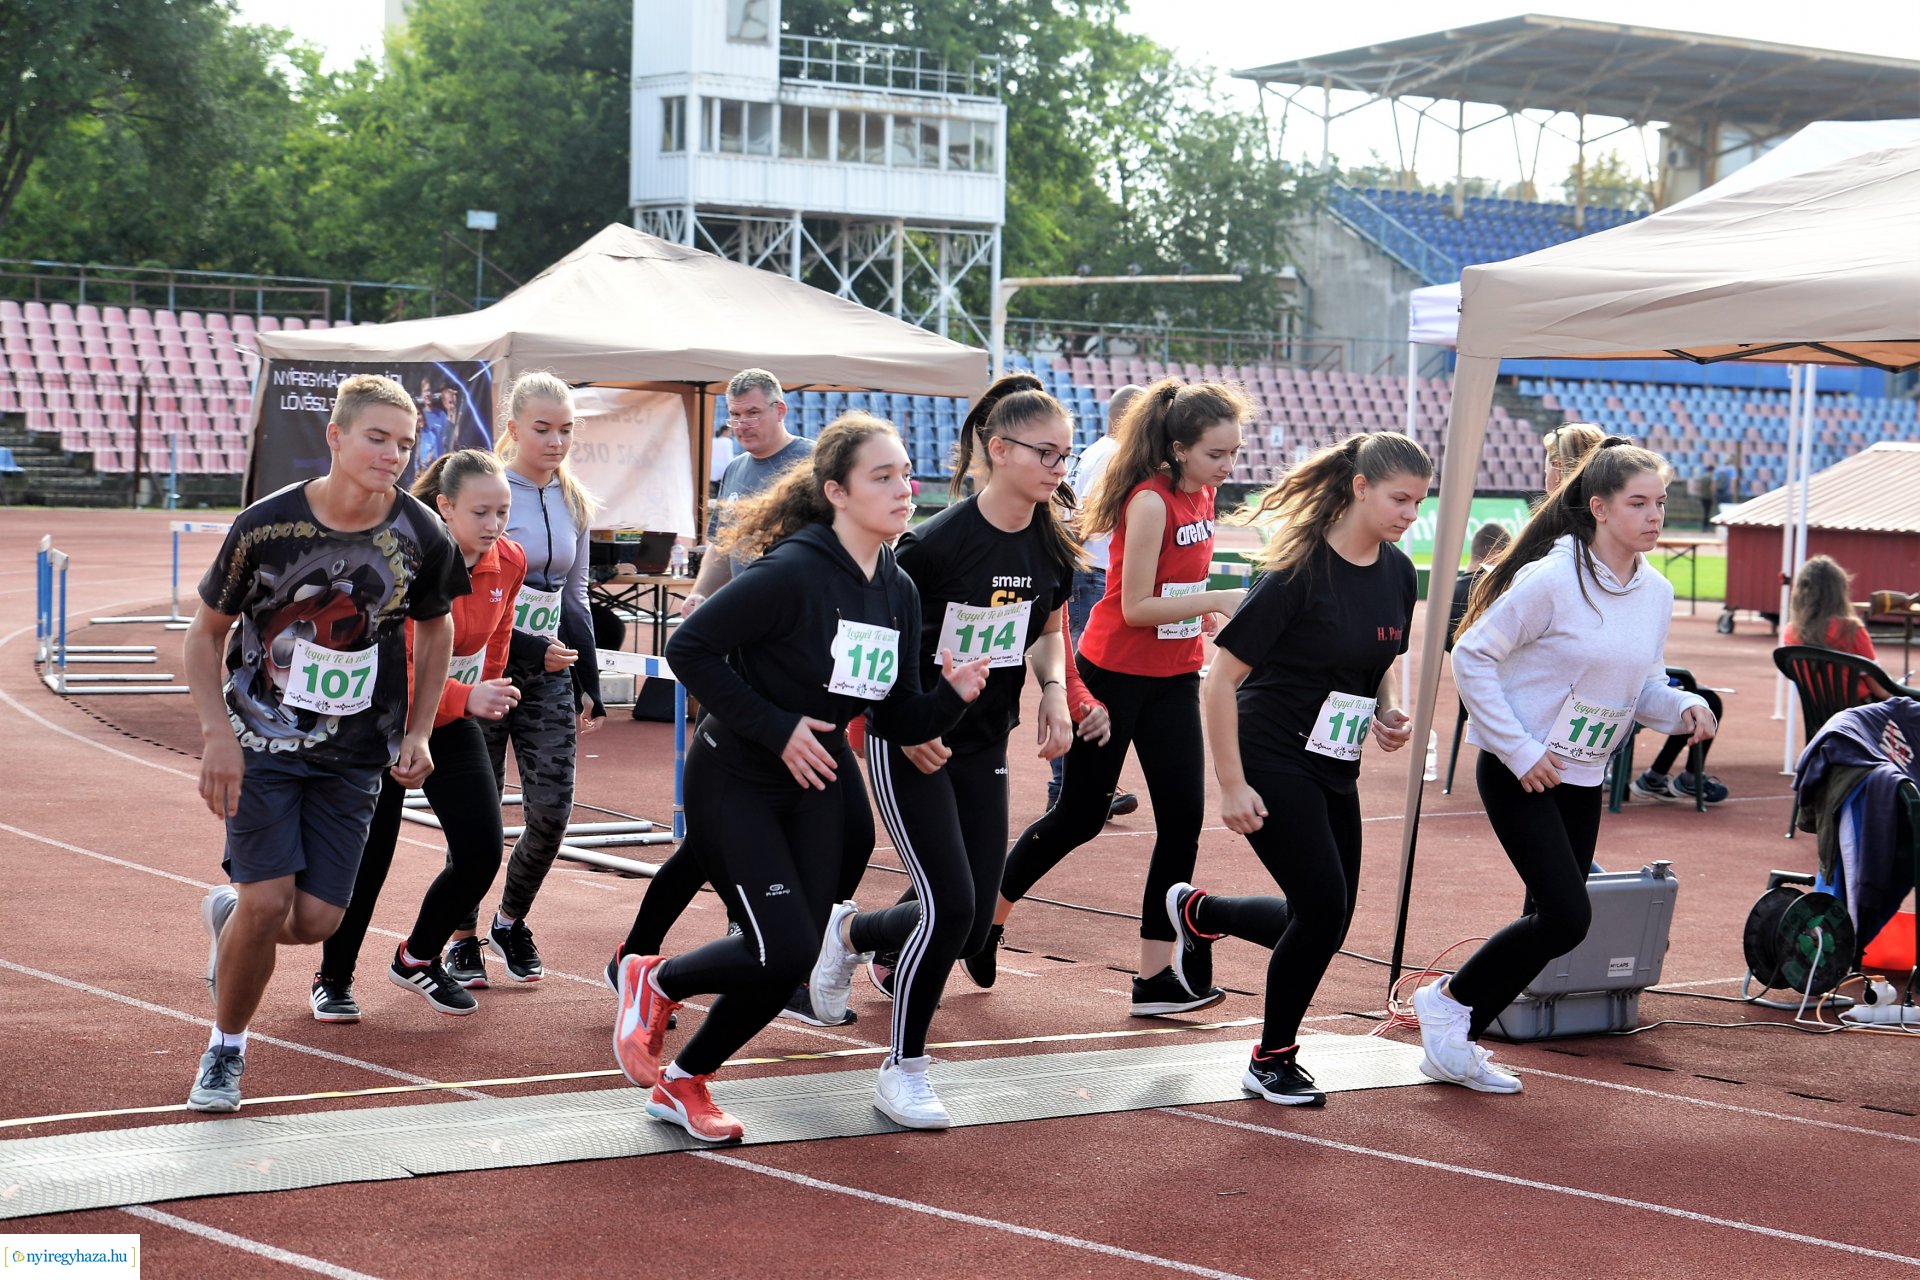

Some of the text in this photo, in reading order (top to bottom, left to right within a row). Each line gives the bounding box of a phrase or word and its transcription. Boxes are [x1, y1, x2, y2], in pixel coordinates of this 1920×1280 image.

[992, 575, 1032, 588] smart
[515, 602, 560, 631] 109
[956, 621, 1016, 653] 114
[848, 644, 894, 684] 112
[303, 663, 371, 699] 107
[1328, 711, 1370, 745] 116
[1568, 716, 1618, 748] 111
